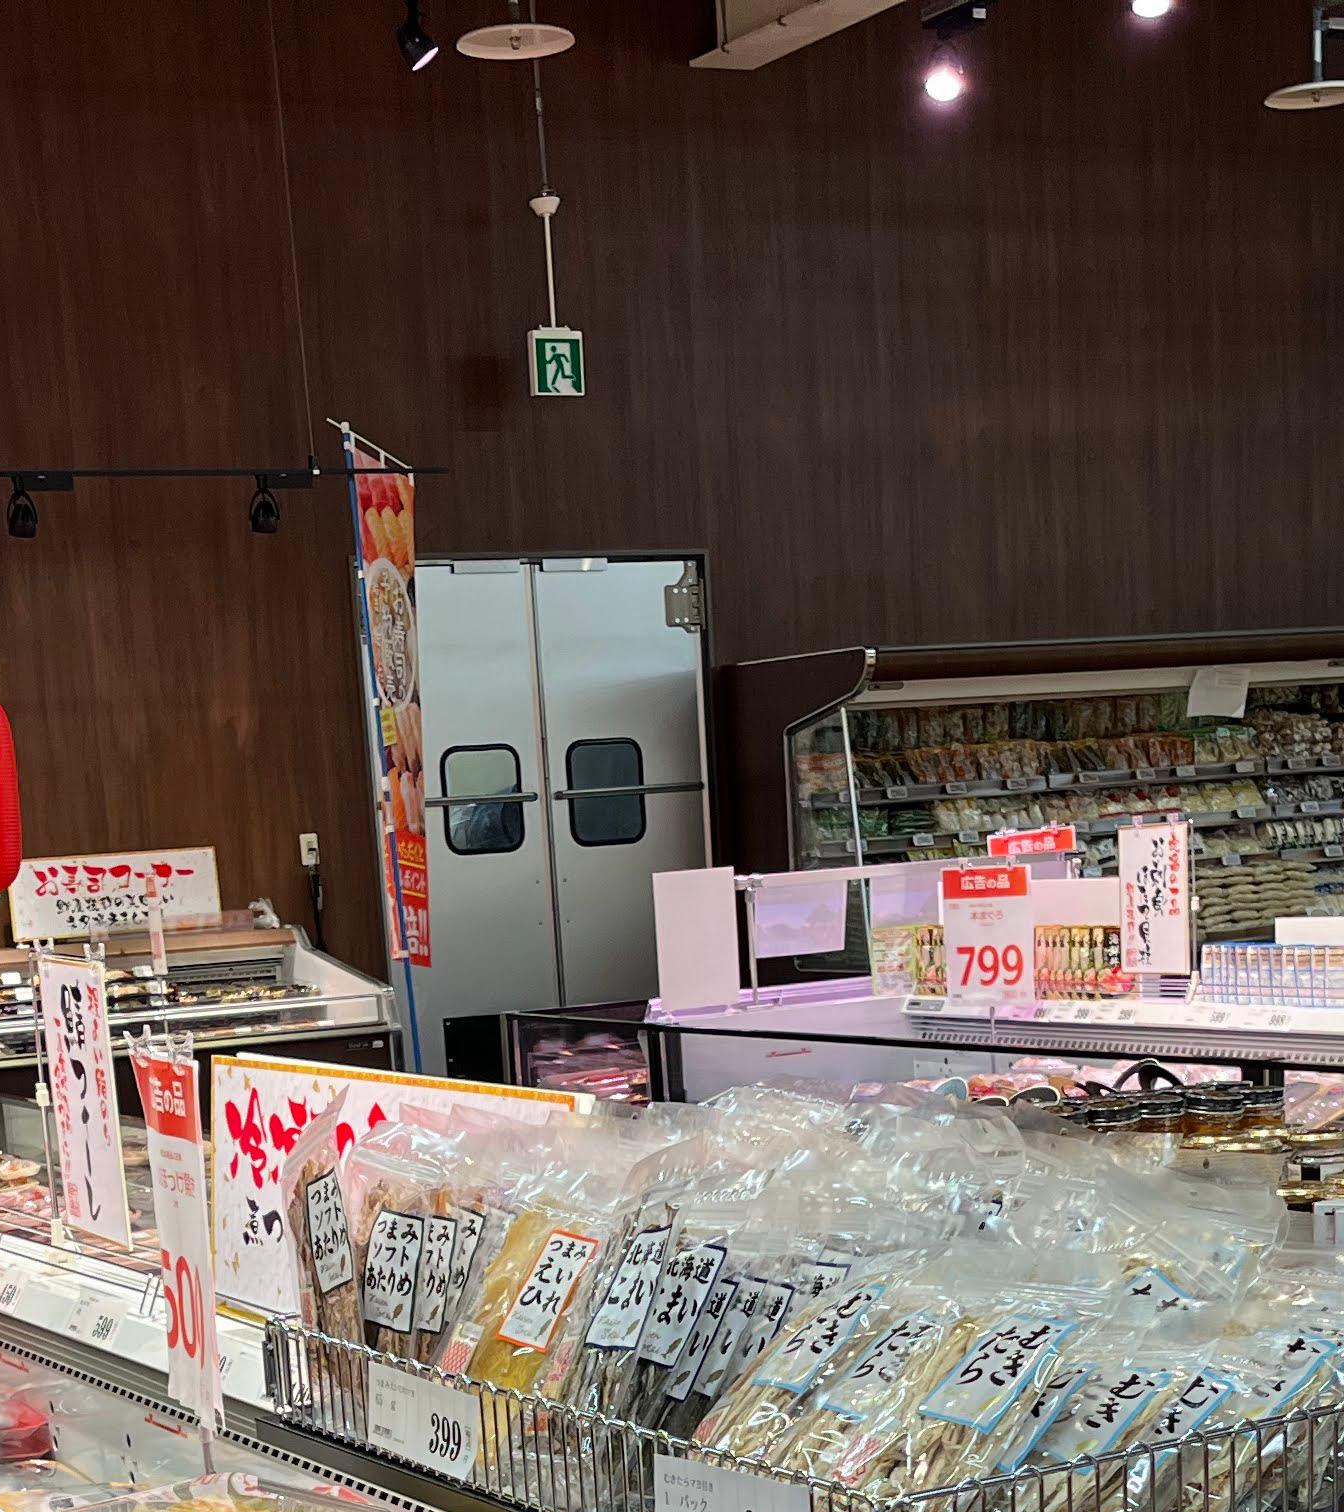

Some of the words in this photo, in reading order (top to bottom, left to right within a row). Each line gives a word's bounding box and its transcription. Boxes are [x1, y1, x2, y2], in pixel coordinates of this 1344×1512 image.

[1007, 836, 1057, 853] 広告の品
[961, 873, 1010, 890] 広告の品
[956, 944, 1023, 986] 799
[376, 1219, 419, 1244] つまみ
[372, 1242, 410, 1268] ソフト
[425, 1248, 445, 1268] フト
[550, 1238, 587, 1260] つまみ
[366, 1265, 413, 1296] あたりめ
[535, 1259, 573, 1283] えい
[666, 1256, 715, 1284] 北海道
[519, 1286, 560, 1313] ひれ
[956, 1324, 1013, 1386] たら
[989, 1324, 1050, 1386] むき
[429, 1413, 462, 1461] 399
[679, 1494, 709, 1512] パック
